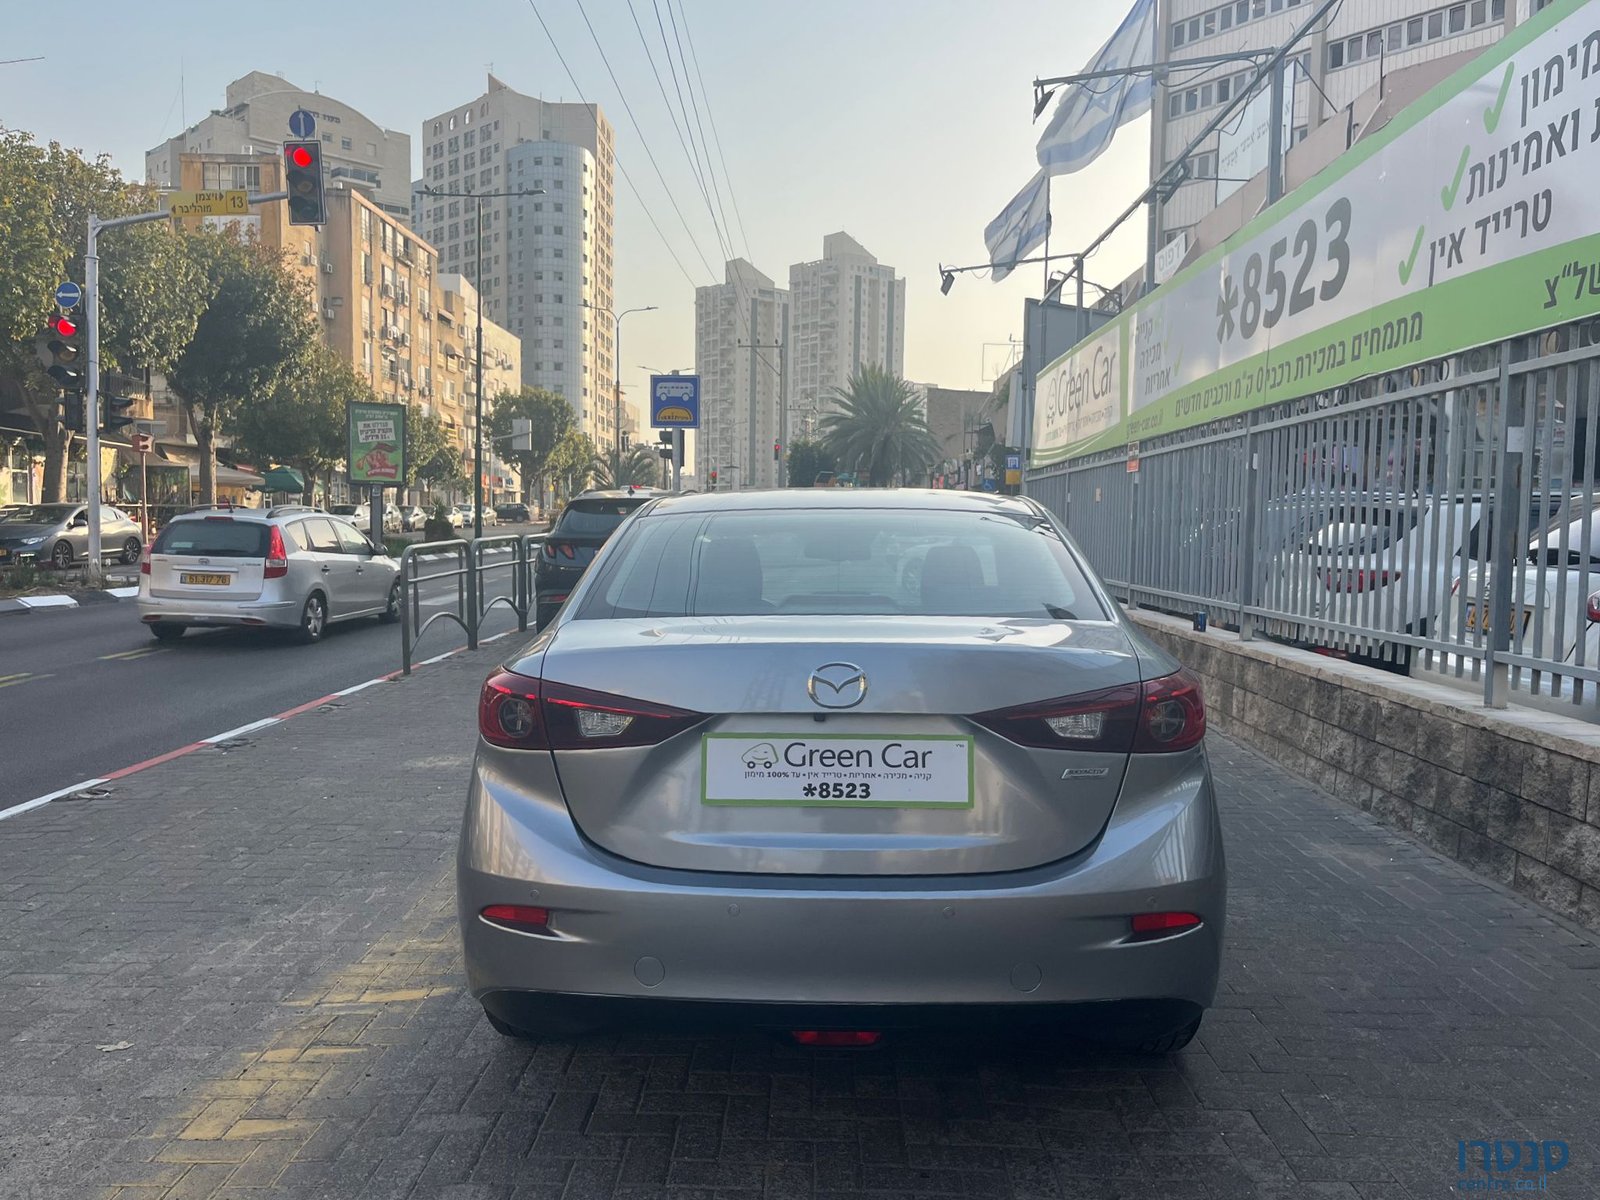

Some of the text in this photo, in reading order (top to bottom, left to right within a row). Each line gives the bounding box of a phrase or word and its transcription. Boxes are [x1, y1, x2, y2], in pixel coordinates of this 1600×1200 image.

[1466, 108, 1580, 205] ואמינות
[195, 192, 218, 204] ויצמן
[230, 195, 244, 209] 13
[1428, 188, 1552, 287] טרייד אין
[1351, 311, 1423, 362] מתמחים
[1294, 340, 1346, 382] במכירת
[1058, 345, 1117, 415] Green Car
[1175, 394, 1202, 418] חדשים
[784, 742, 933, 769] Green Car
[744, 771, 932, 781] קניה מכירה אחריות טרייד אין עד 100% מימון
